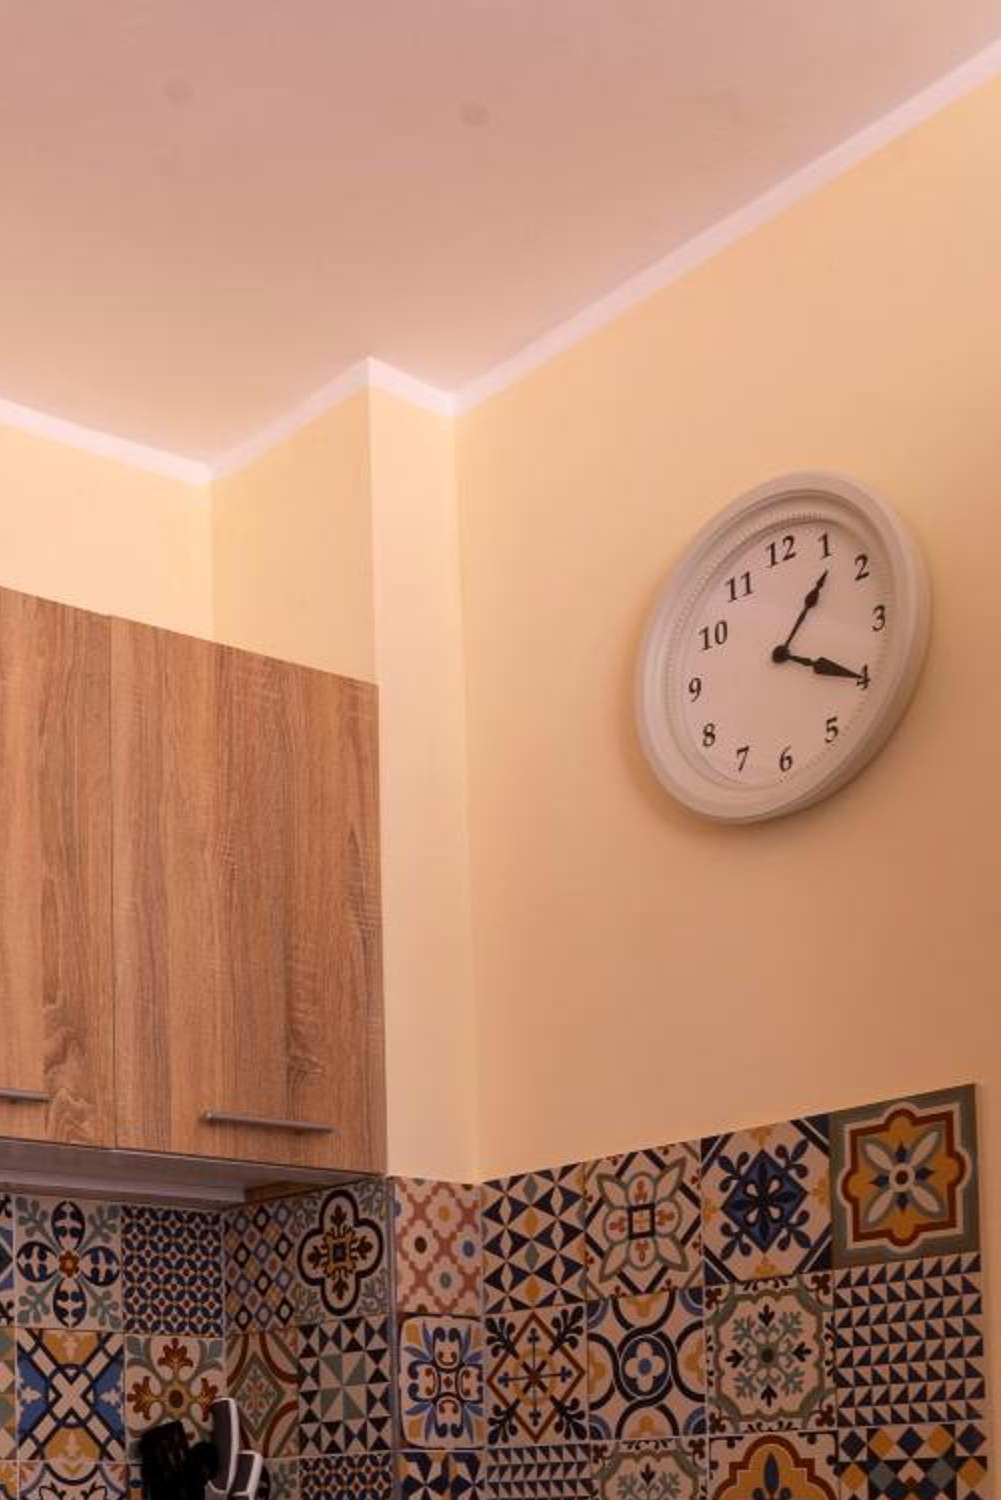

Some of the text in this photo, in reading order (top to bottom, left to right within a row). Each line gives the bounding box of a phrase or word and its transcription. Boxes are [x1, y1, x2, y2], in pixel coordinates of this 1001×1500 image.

[765, 535, 797, 568] 12
[817, 533, 833, 560] 1
[854, 554, 870, 580] 2
[725, 571, 754, 602] 11
[872, 605, 886, 631] 3
[698, 620, 728, 650] 10
[688, 677, 702, 702] 9
[856, 664, 870, 690] 4
[702, 723, 716, 747] 8
[824, 717, 839, 743] 5
[736, 746, 750, 772] 7
[779, 746, 793, 772] 6
